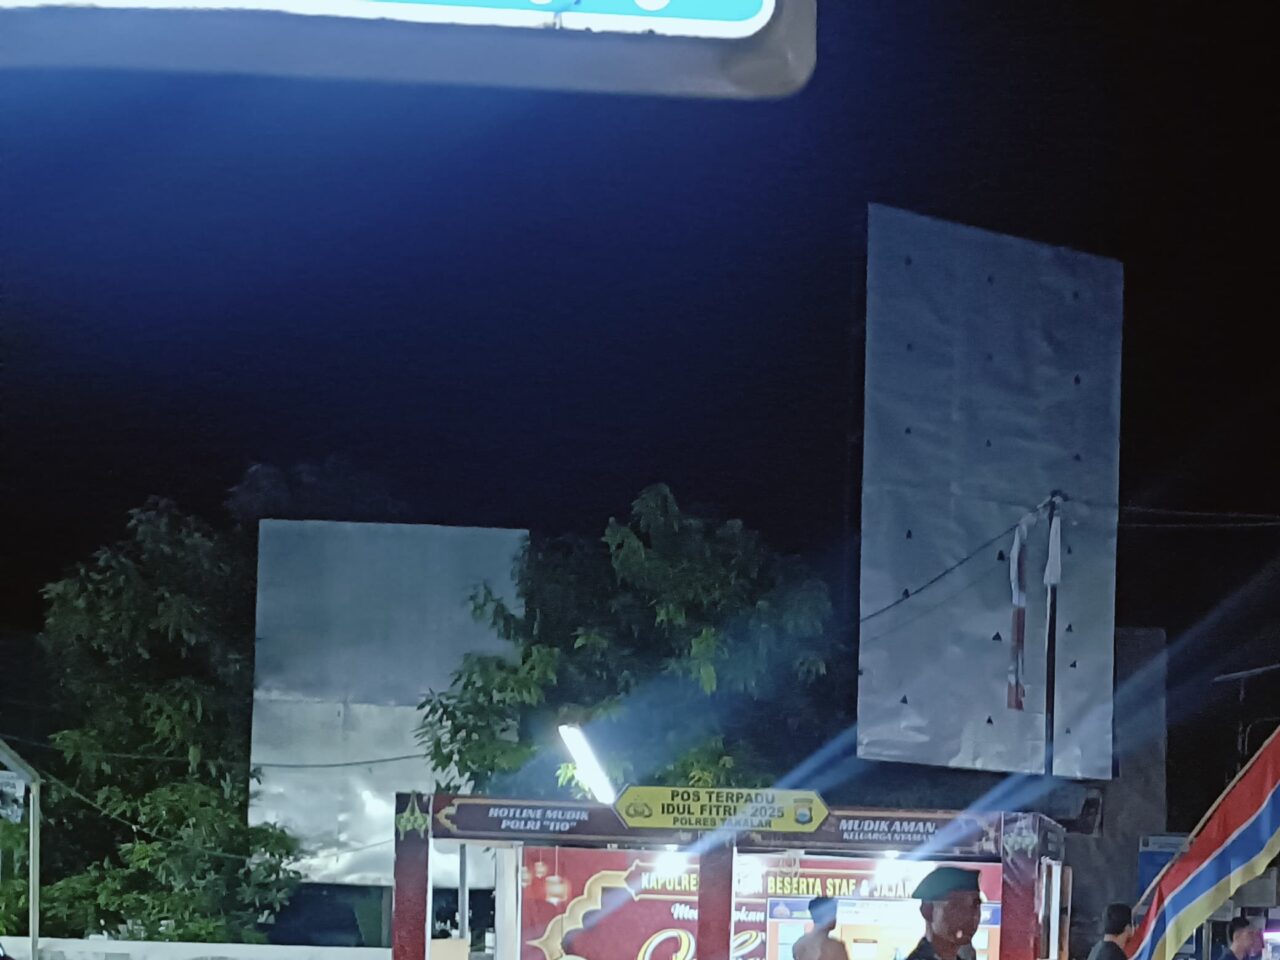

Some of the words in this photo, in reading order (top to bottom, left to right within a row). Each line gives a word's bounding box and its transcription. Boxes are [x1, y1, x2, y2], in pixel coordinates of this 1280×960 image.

[670, 789, 701, 802] POS
[705, 790, 776, 805] TERPADU
[487, 807, 543, 819] HOTLINE
[545, 809, 589, 821] MUDIK
[661, 803, 695, 816] IDUL
[699, 804, 737, 817] FITRI
[751, 806, 785, 818] 2025
[501, 819, 541, 830] POLRI
[672, 816, 717, 828] POLRES
[839, 819, 889, 832] MUDIK
[842, 831, 892, 842] KELUARGA
[641, 872, 698, 891] KAPOLRE
[767, 876, 823, 896] BESERTA
[826, 877, 857, 896] STAF
